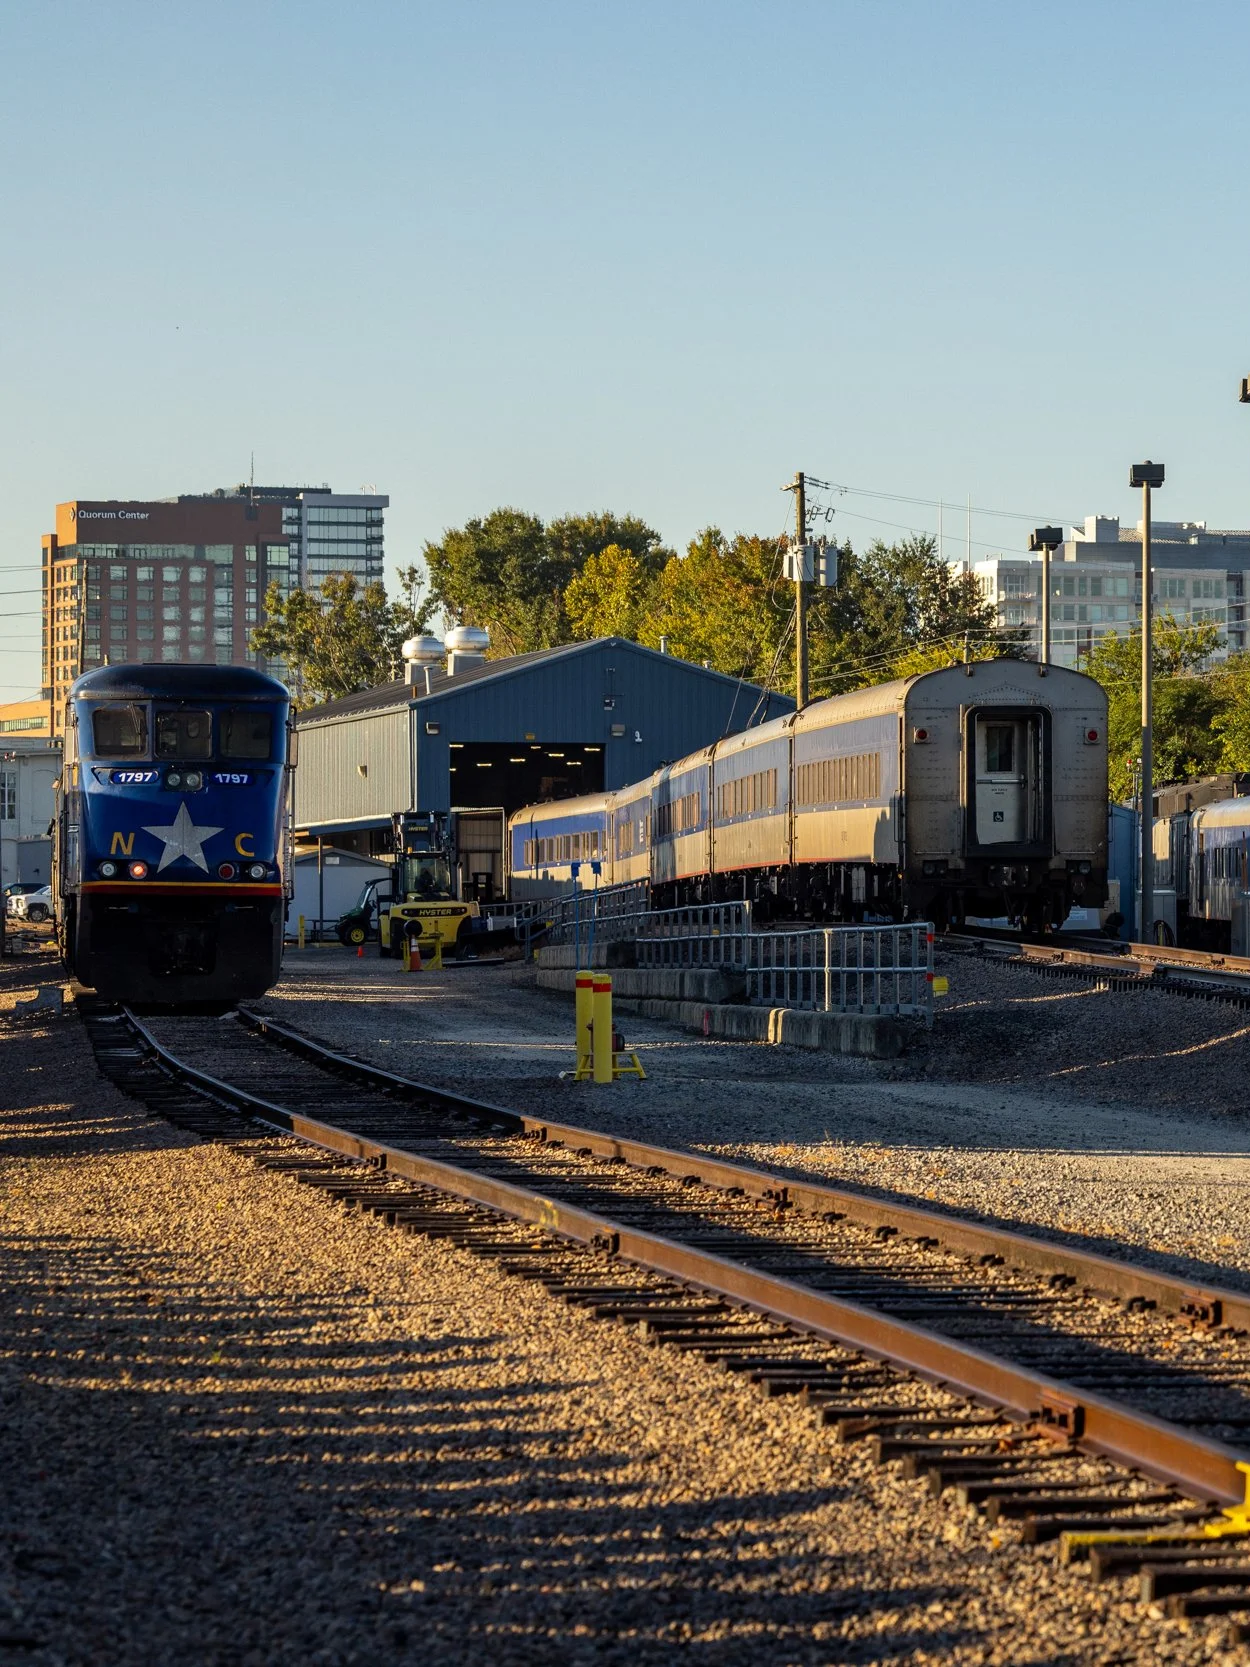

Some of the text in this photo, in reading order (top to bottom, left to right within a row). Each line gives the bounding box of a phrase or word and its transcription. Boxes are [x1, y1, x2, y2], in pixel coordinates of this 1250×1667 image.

[79, 510, 150, 519] Quorum Center
[118, 772, 153, 783] 1797
[215, 773, 249, 784] 1797
[110, 832, 255, 857] N C
